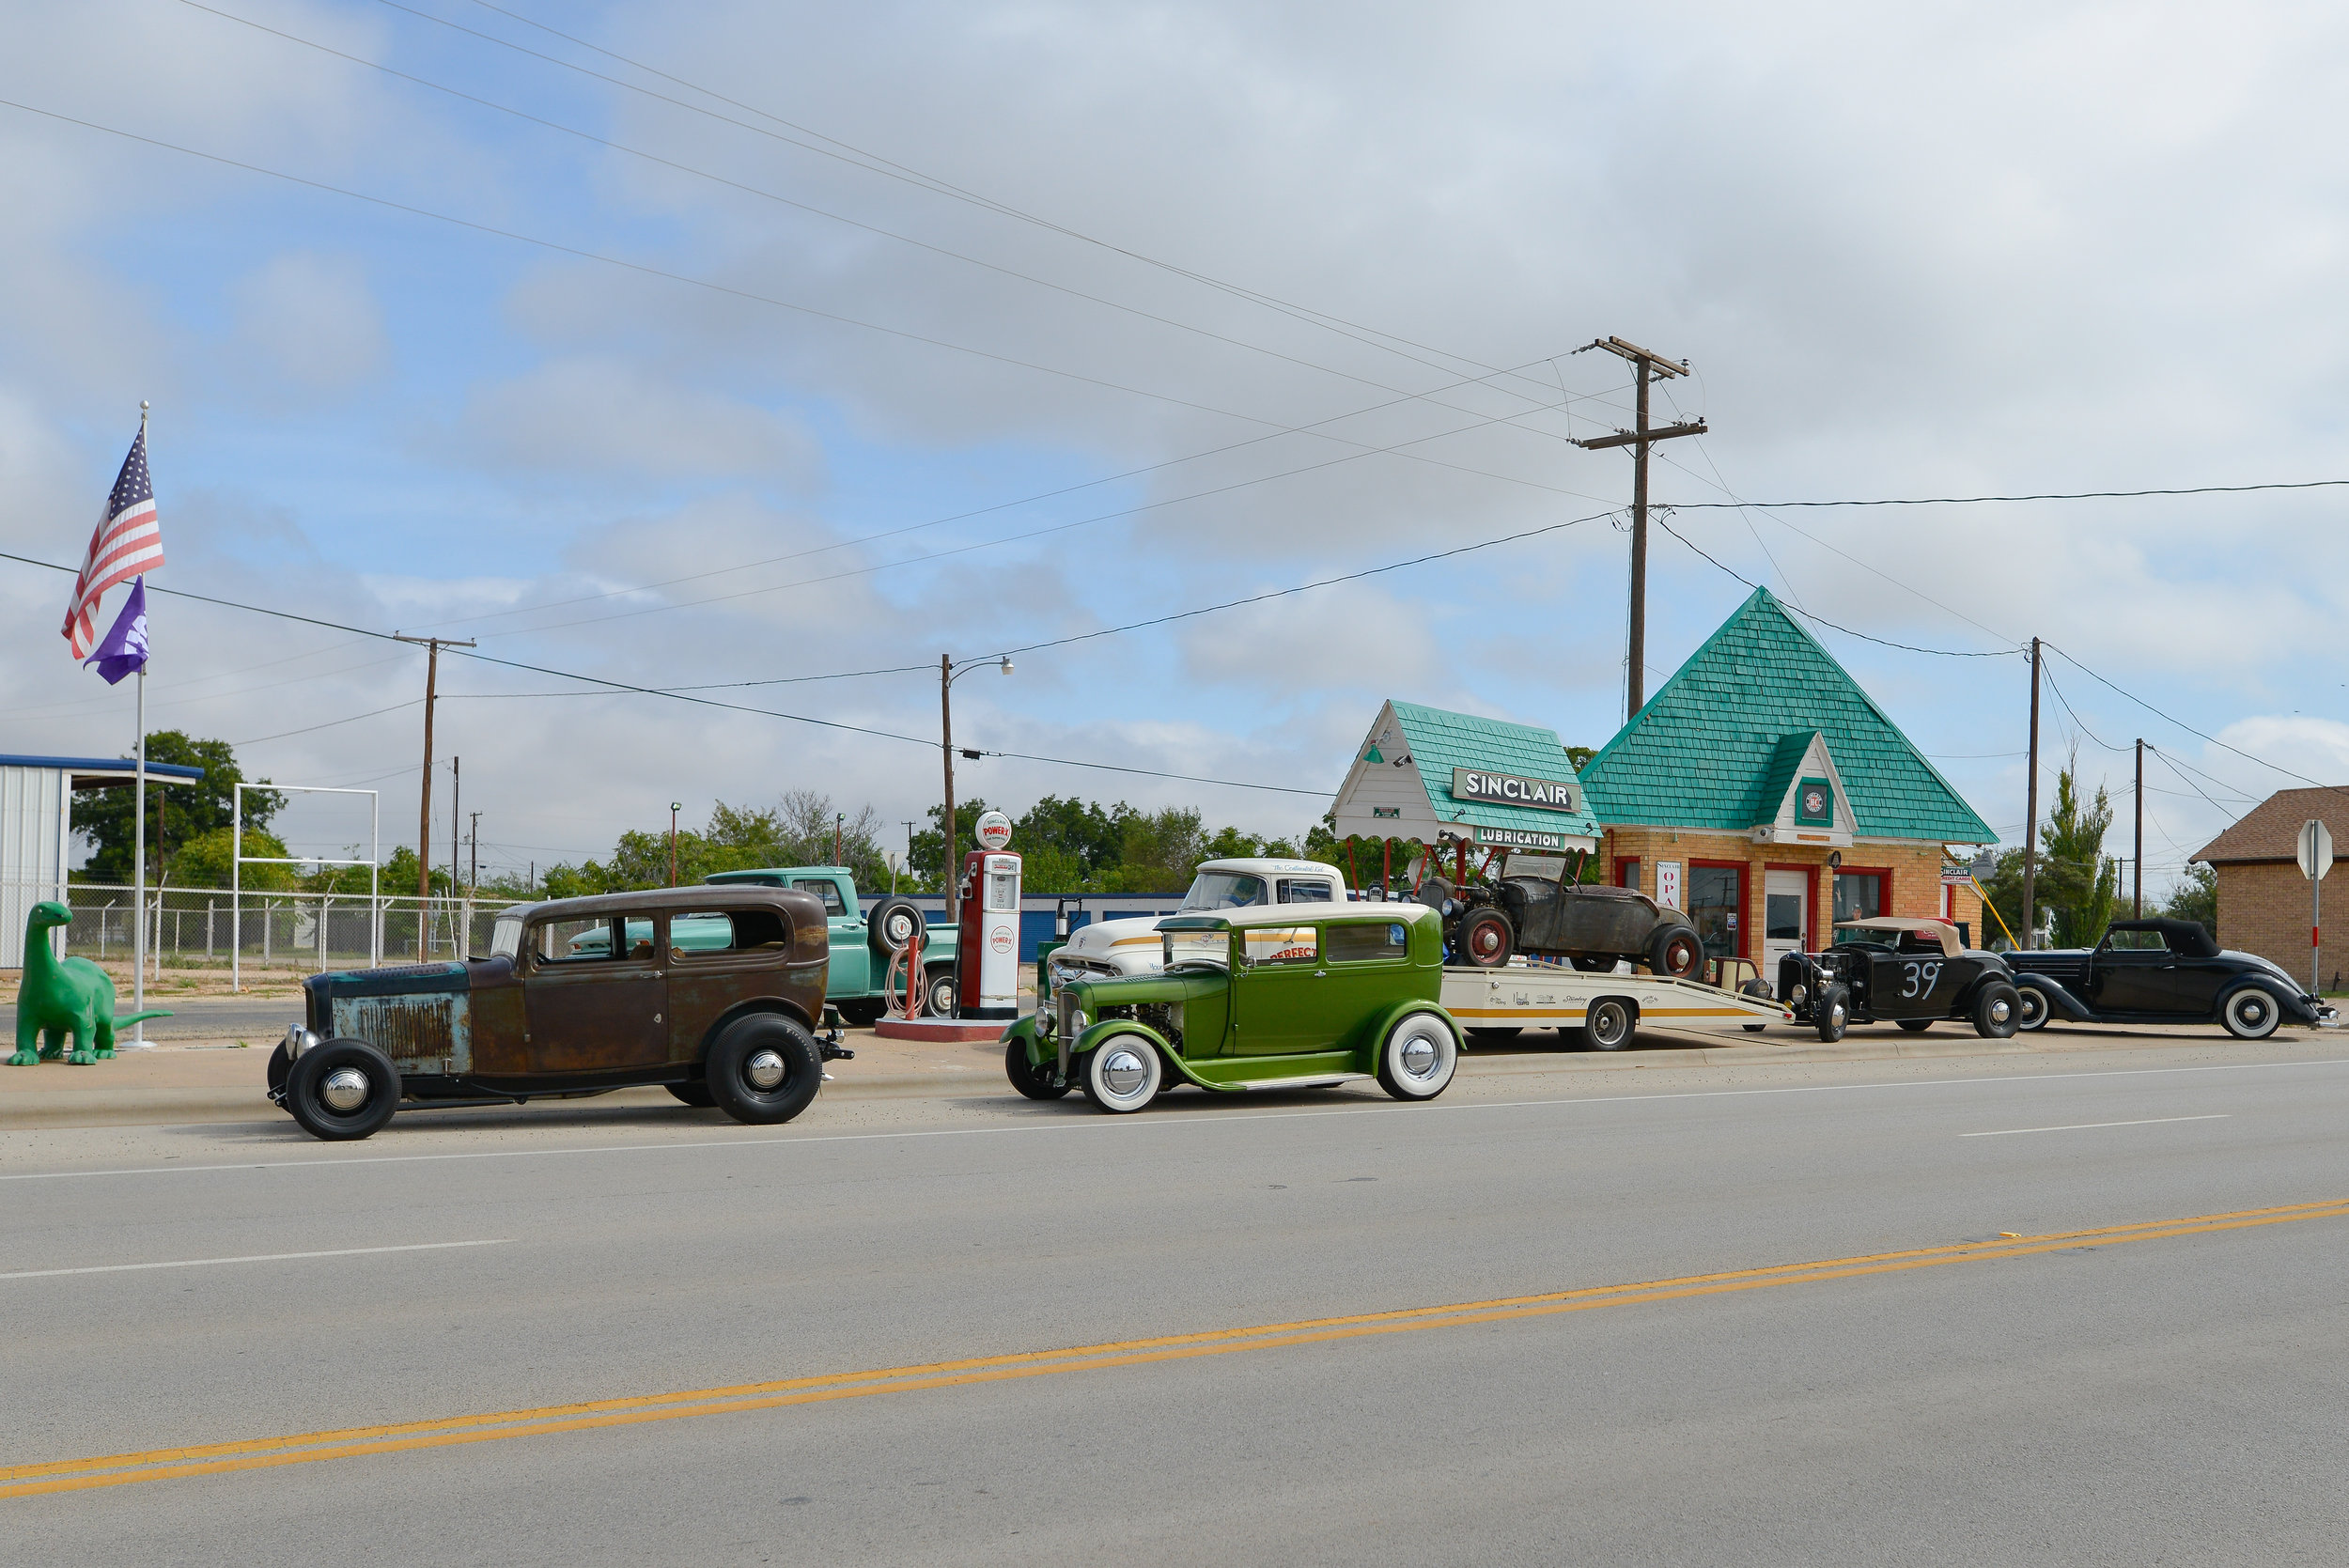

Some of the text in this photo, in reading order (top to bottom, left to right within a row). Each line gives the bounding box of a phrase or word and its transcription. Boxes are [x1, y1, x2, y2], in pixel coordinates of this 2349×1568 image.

[1465, 772, 1568, 805] SINCLAIR
[1481, 829, 1559, 847] LUBRICATION
[1902, 961, 1940, 1001] 39
